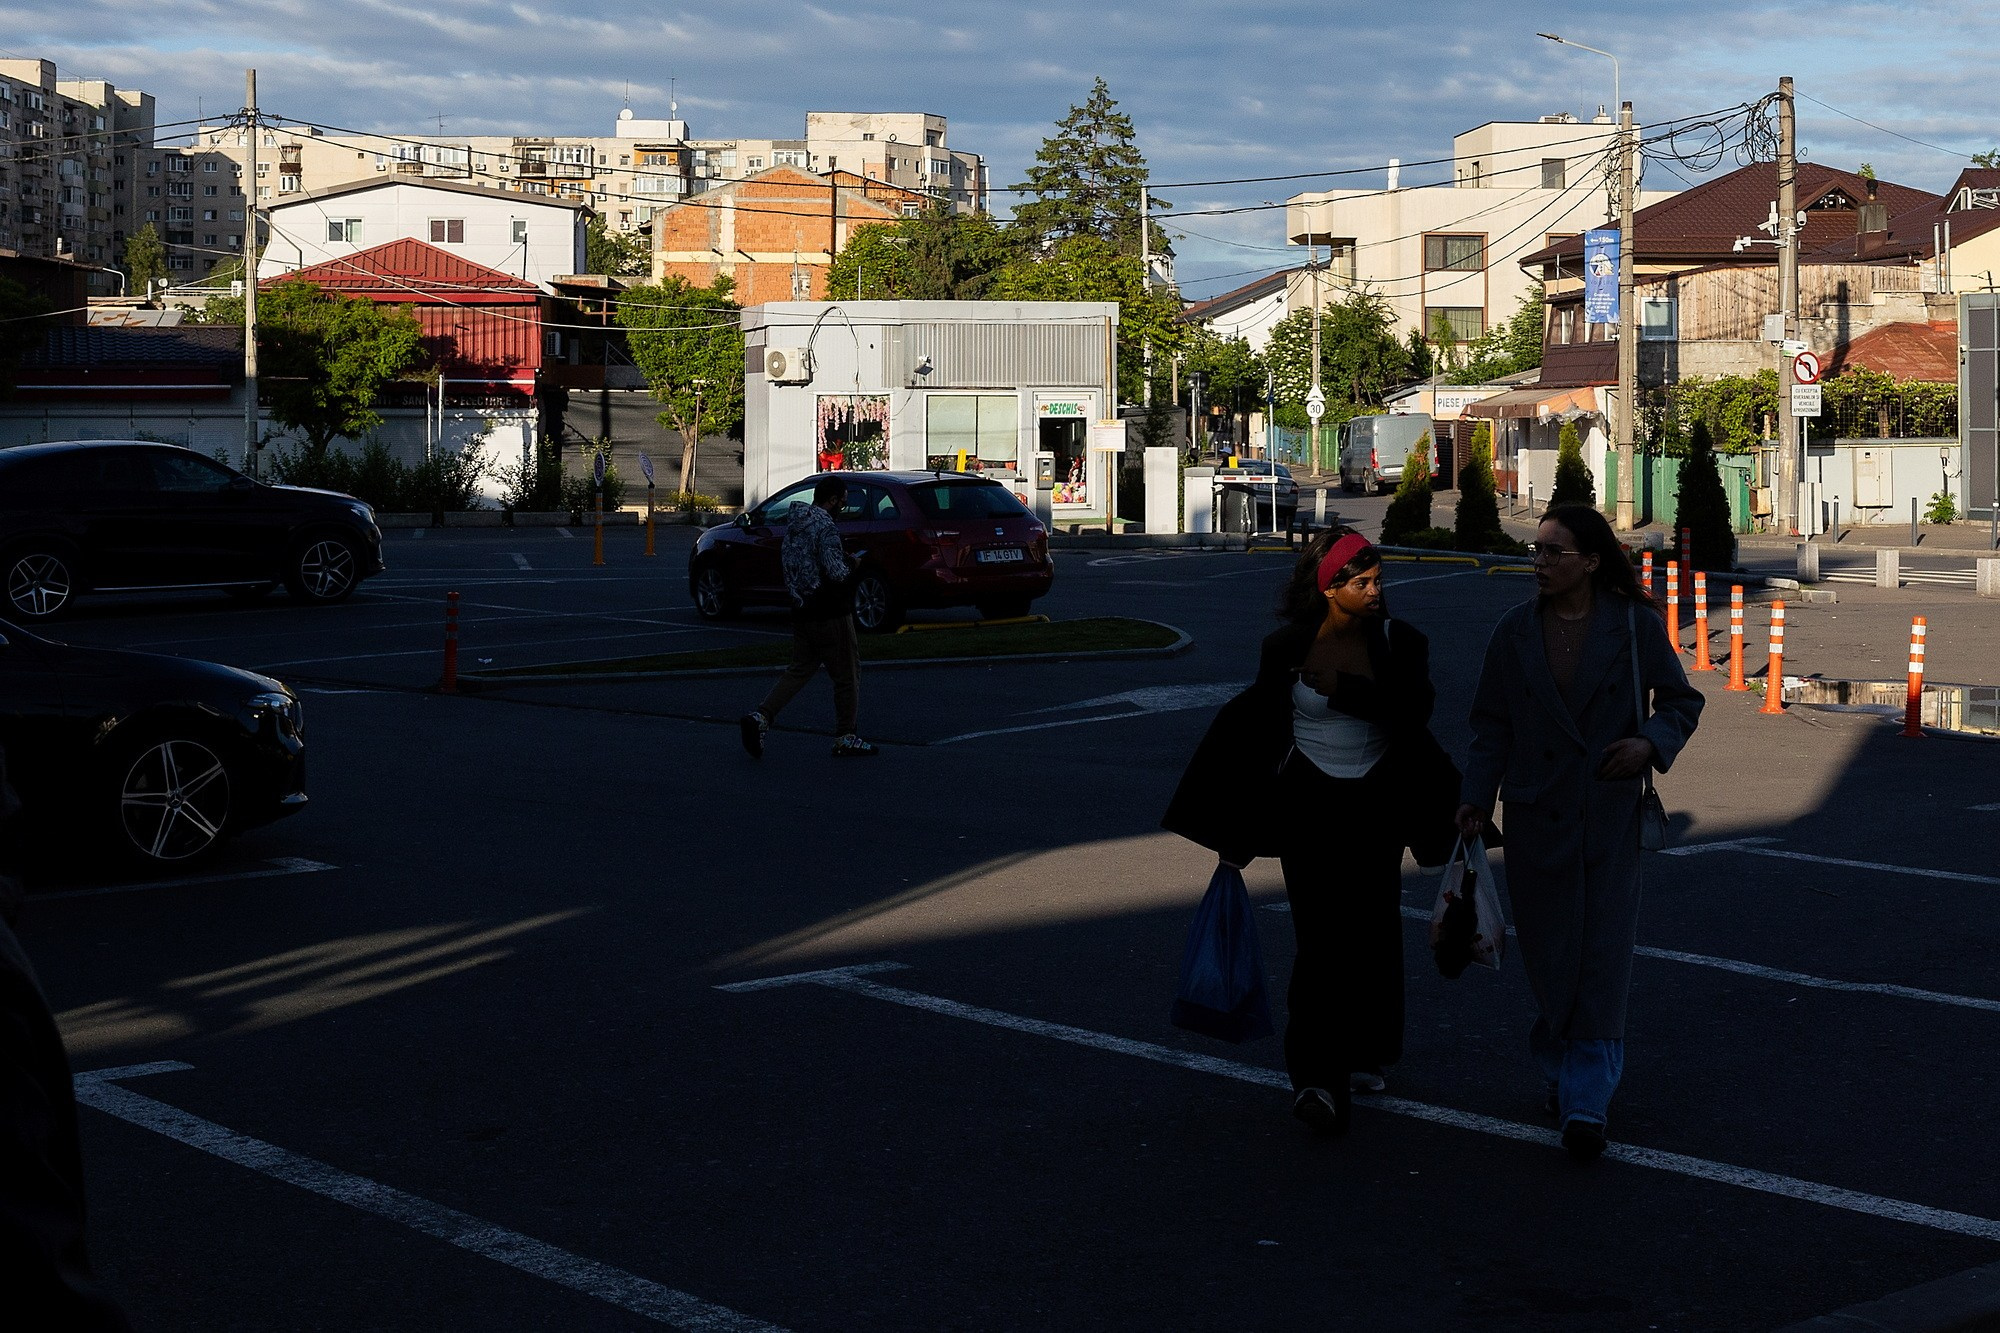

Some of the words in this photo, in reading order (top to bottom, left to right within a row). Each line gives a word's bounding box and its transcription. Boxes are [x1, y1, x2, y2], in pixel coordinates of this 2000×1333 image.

[460, 395, 512, 406] ELECTRICE
[1437, 397, 1460, 408] PIESE
[1049, 403, 1078, 415] DESCHIS
[1310, 404, 1320, 414] 30
[983, 551, 990, 560] IF
[1003, 550, 1018, 559] GTV
